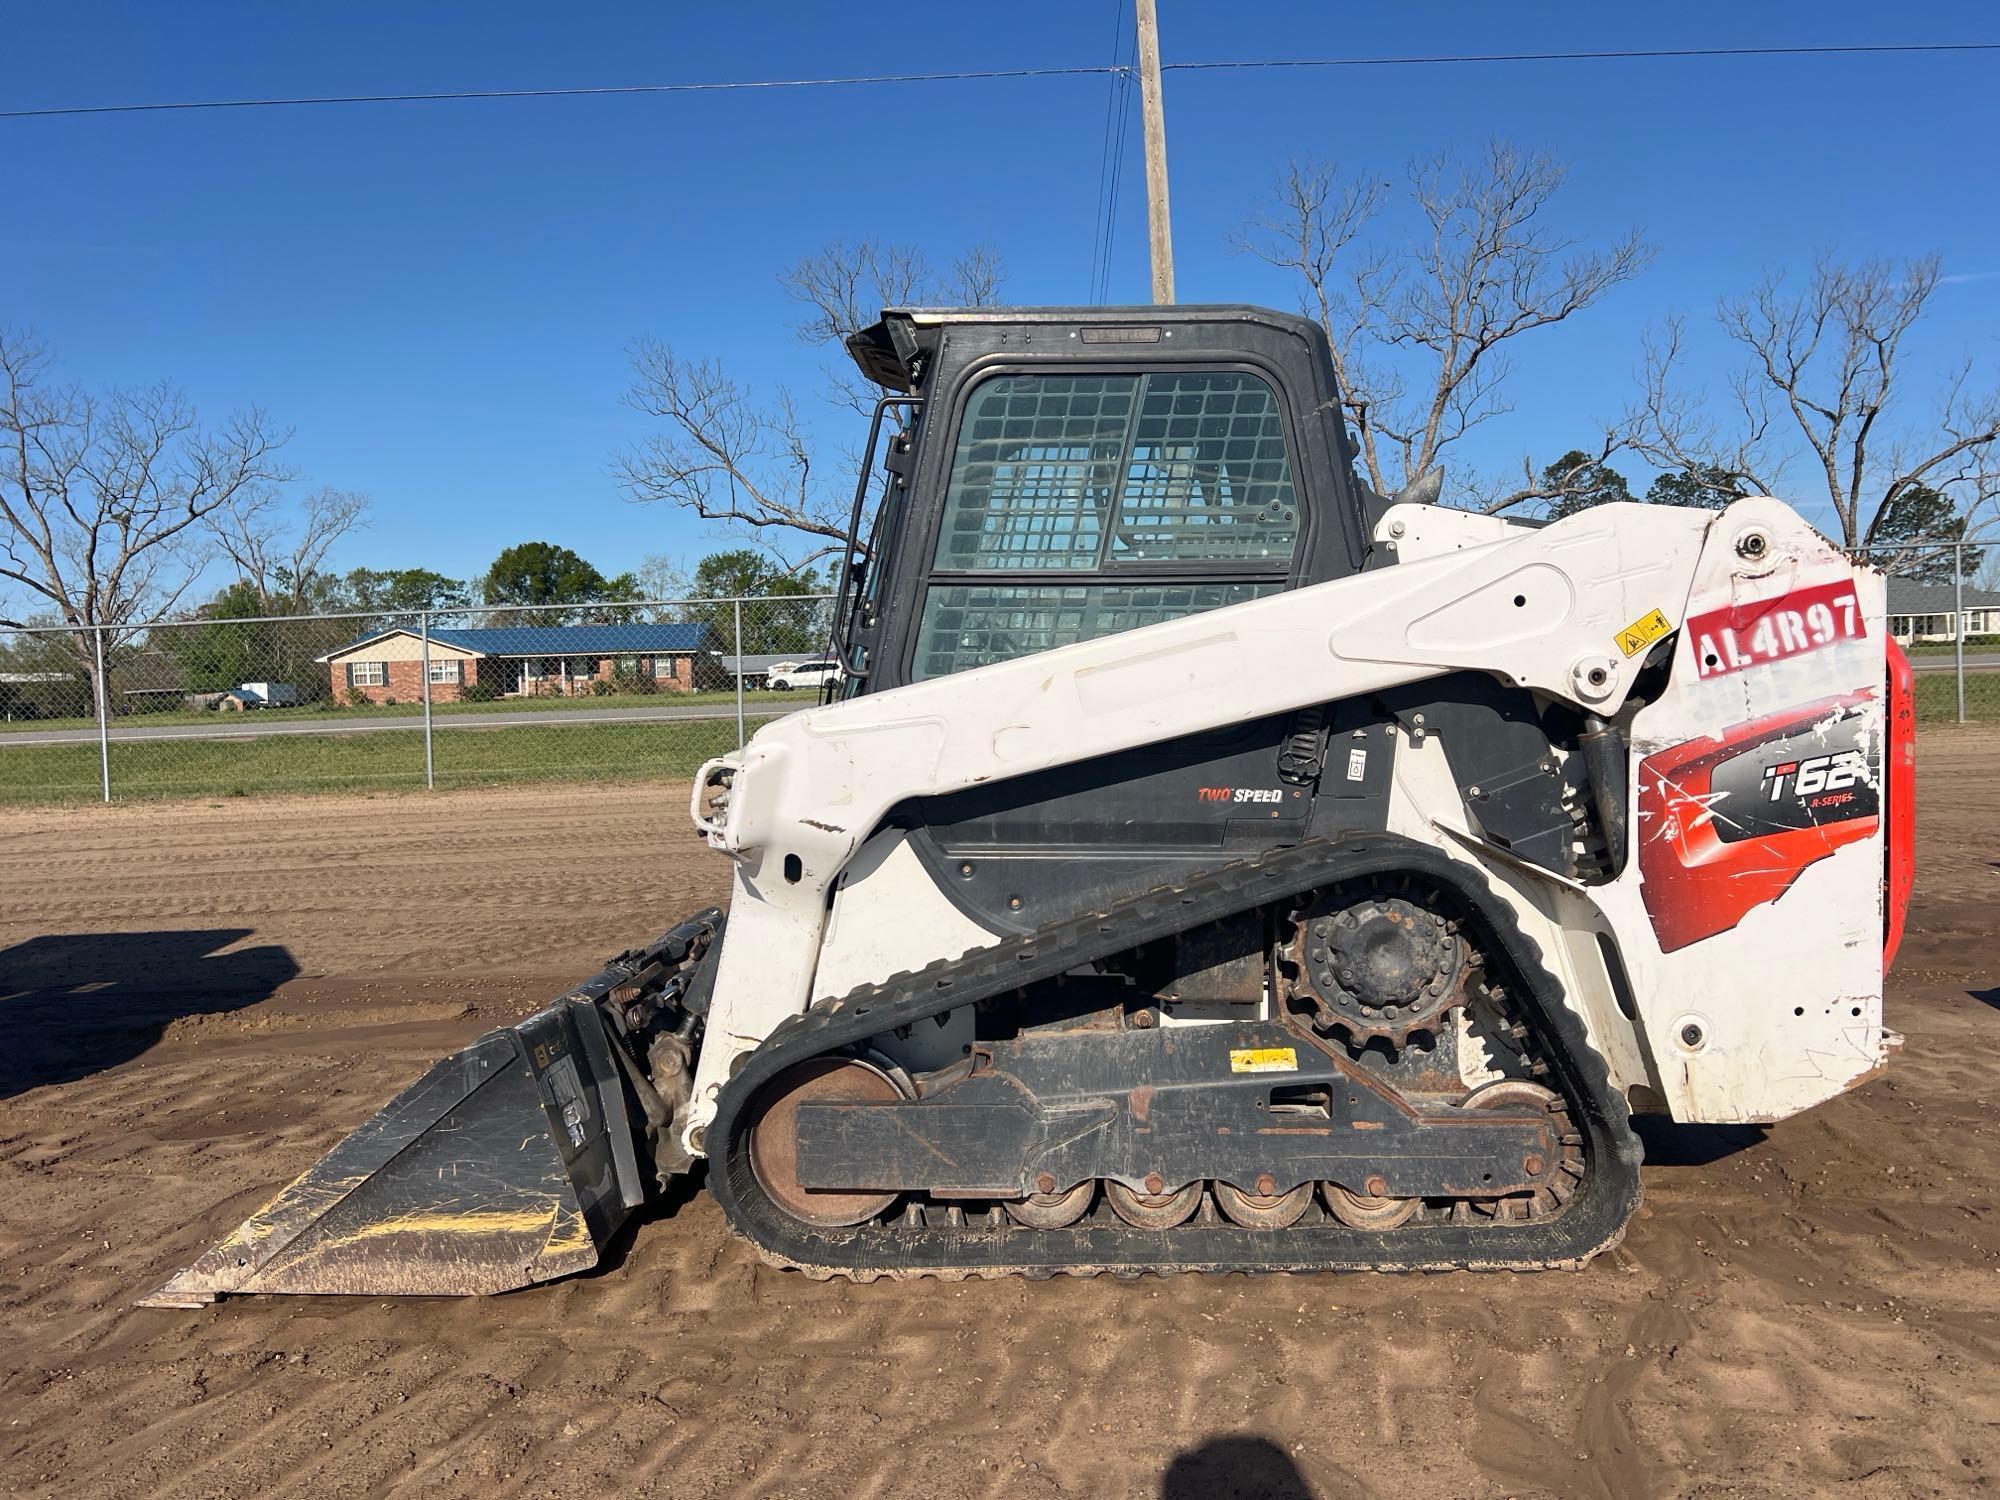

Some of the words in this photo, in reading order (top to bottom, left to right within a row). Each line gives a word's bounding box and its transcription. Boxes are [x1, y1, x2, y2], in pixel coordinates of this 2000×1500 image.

[1700, 594, 1857, 676] AL4R97
[1764, 749, 1863, 802] T62
[1199, 787, 1231, 801] TWO
[1233, 788, 1283, 803] SPEED
[1810, 792, 1854, 808] R-SERIES
